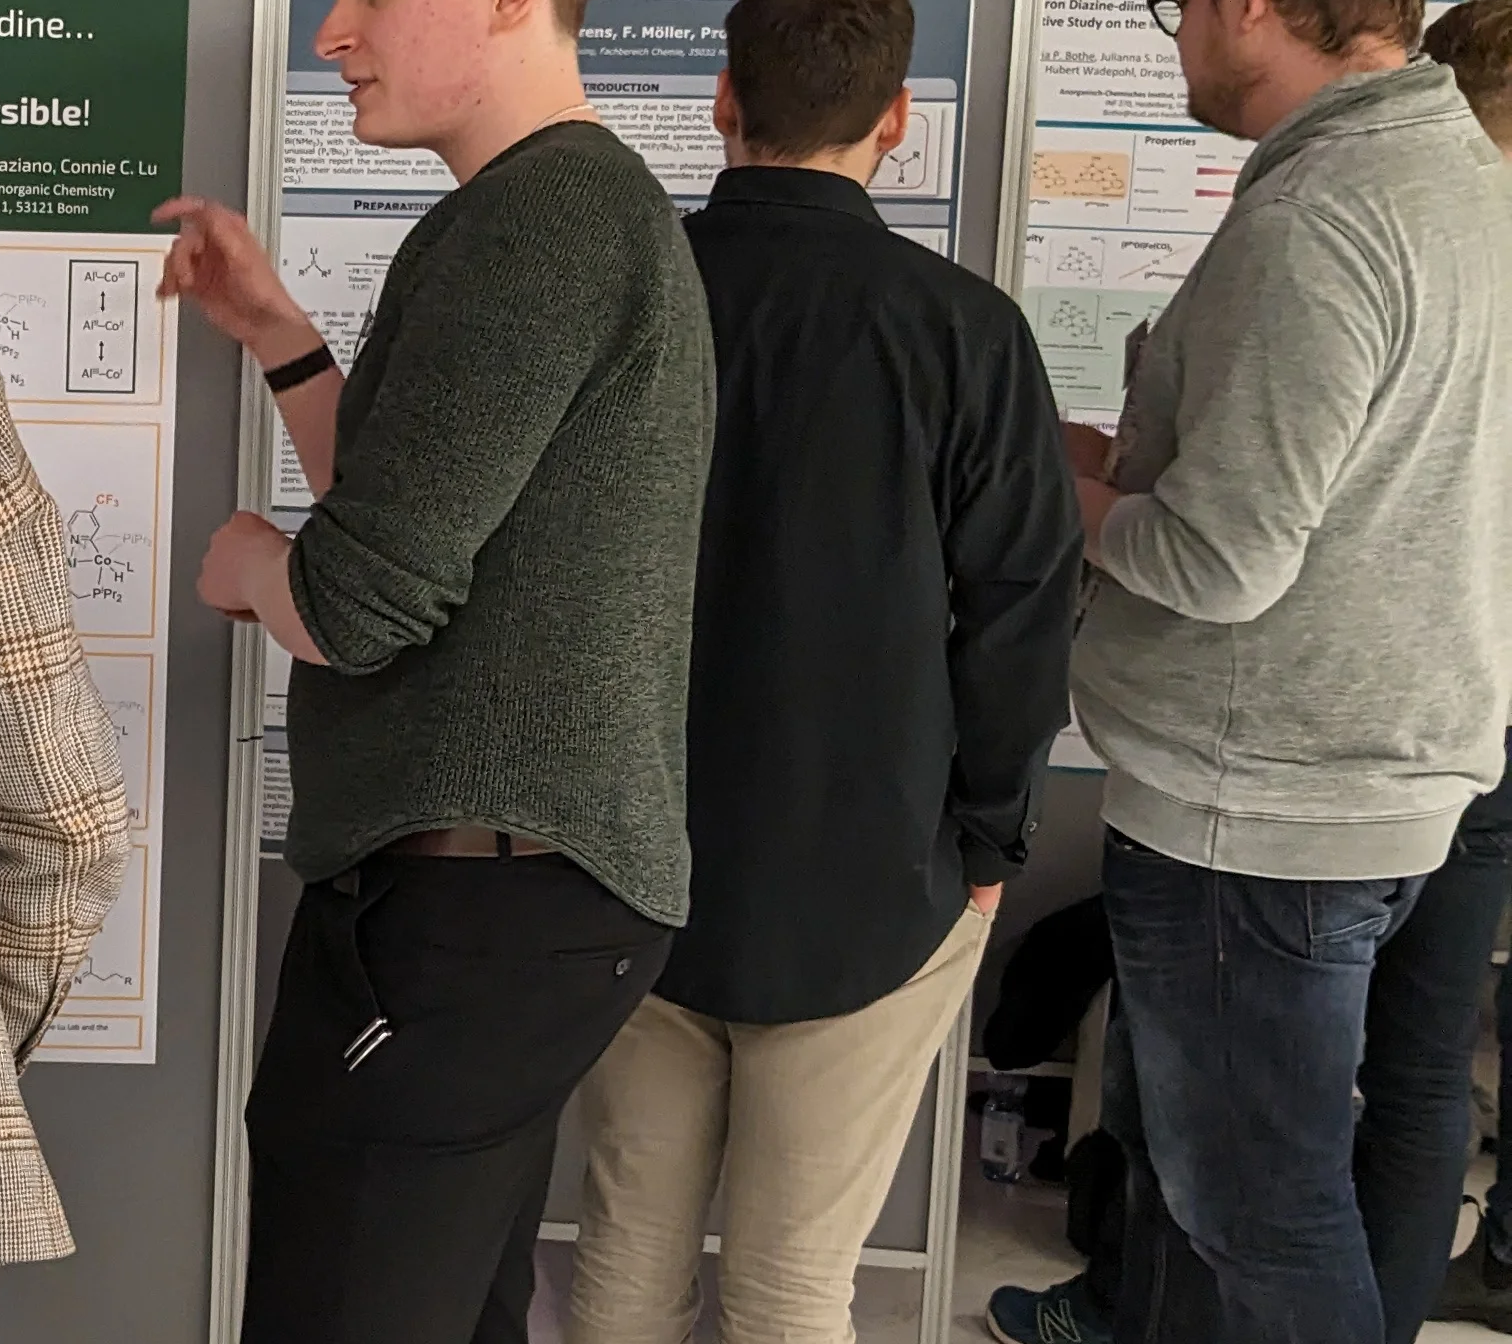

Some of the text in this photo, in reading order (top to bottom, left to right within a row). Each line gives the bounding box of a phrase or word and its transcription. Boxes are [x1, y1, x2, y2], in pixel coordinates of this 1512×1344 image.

[1044, 0, 1148, 12] ron Diazine-diim
[1042, 16, 1147, 30] tive Study on the
[579, 26, 696, 41] rens, F. Möller,
[1100, 52, 1141, 63] Julianna
[1045, 65, 1137, 79] Hubert Wadepohl,
[583, 82, 660, 93] TRODUCTION
[1144, 135, 1197, 147] Properties
[60, 159, 116, 176] Connie
[120, 160, 134, 176] C.
[138, 160, 158, 176] Lu
[52, 184, 115, 200] Chemistry
[1, 200, 13, 215] 1,
[16, 200, 54, 214] 53121
[57, 201, 89, 215] Bonn
